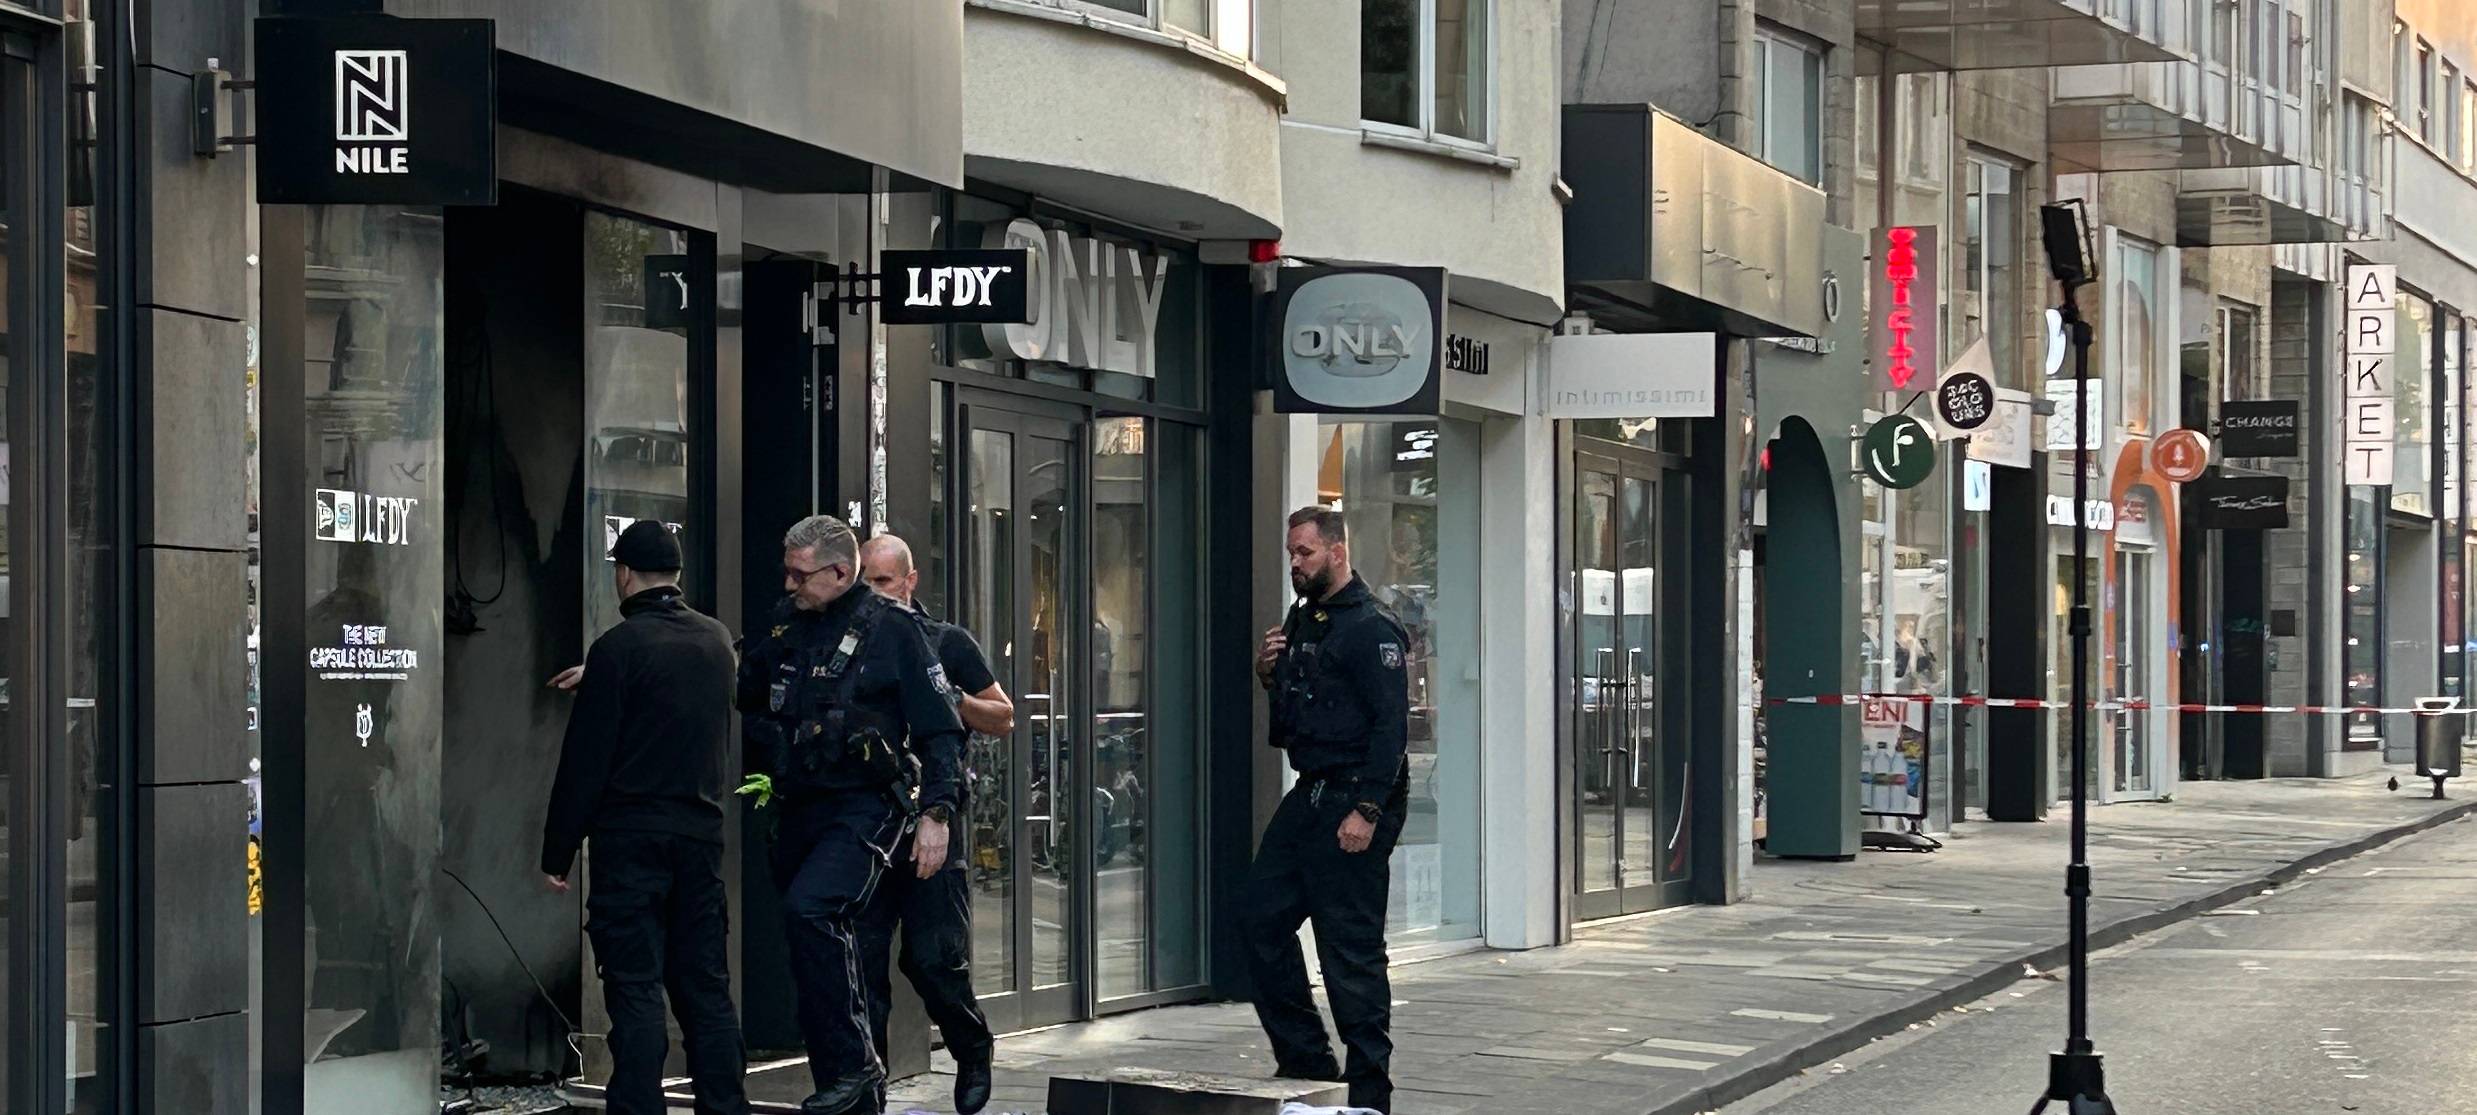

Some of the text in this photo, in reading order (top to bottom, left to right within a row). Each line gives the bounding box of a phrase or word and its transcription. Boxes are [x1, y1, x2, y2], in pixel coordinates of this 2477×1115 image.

[335, 147, 409, 174] NILE
[1001, 217, 1169, 378] ONLY
[1291, 324, 1424, 358] ONLY
[2356, 271, 2386, 479] ARKET
[2225, 415, 2294, 429] CHANGE
